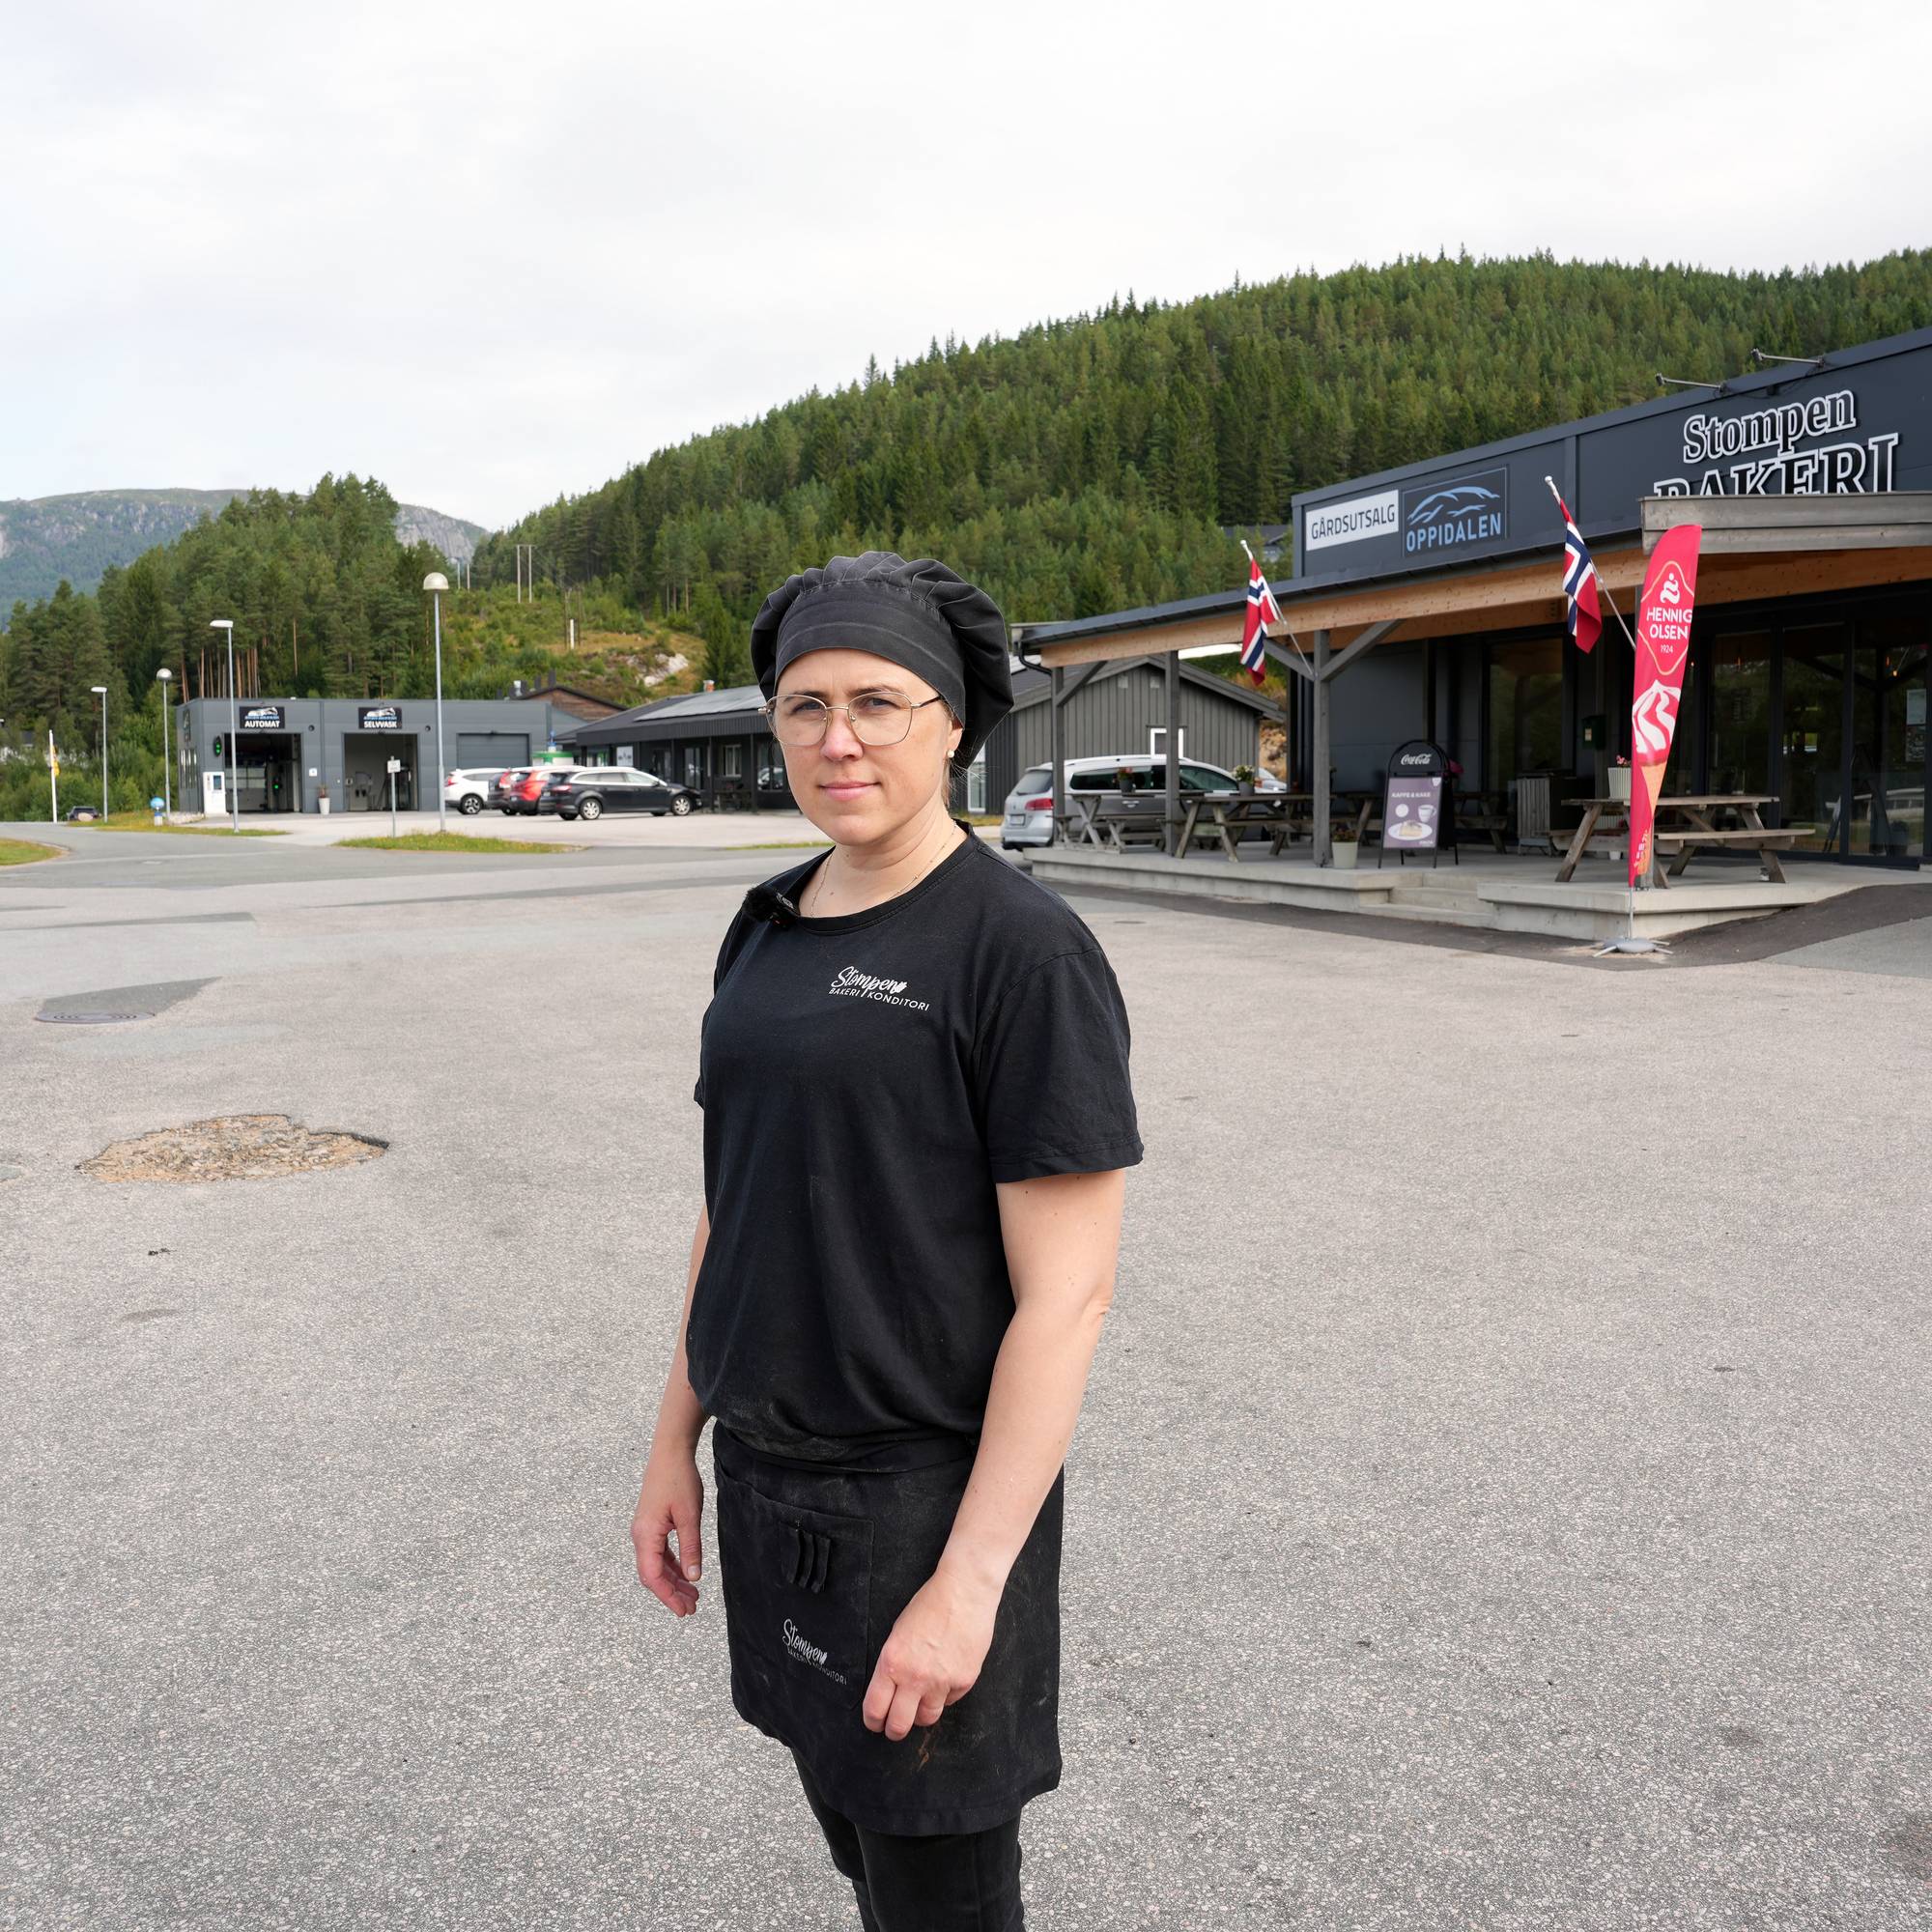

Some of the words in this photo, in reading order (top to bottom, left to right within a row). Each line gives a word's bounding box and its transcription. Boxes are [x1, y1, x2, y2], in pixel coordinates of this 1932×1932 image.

[1683, 389, 1857, 464] Stompen
[1311, 503, 1396, 540] GÅRDSUTSALG
[1406, 512, 1501, 552] OPPIDALEN
[1646, 607, 1692, 623] HENNIG
[1649, 624, 1689, 639] OLSEN
[1661, 644, 1674, 653] 1924
[244, 720, 280, 728] AUTOMAT
[831, 966, 907, 998] Stompen
[829, 987, 861, 998] BAKERI
[867, 991, 930, 1011] KONDITORI
[782, 1618, 828, 1665] Stompen
